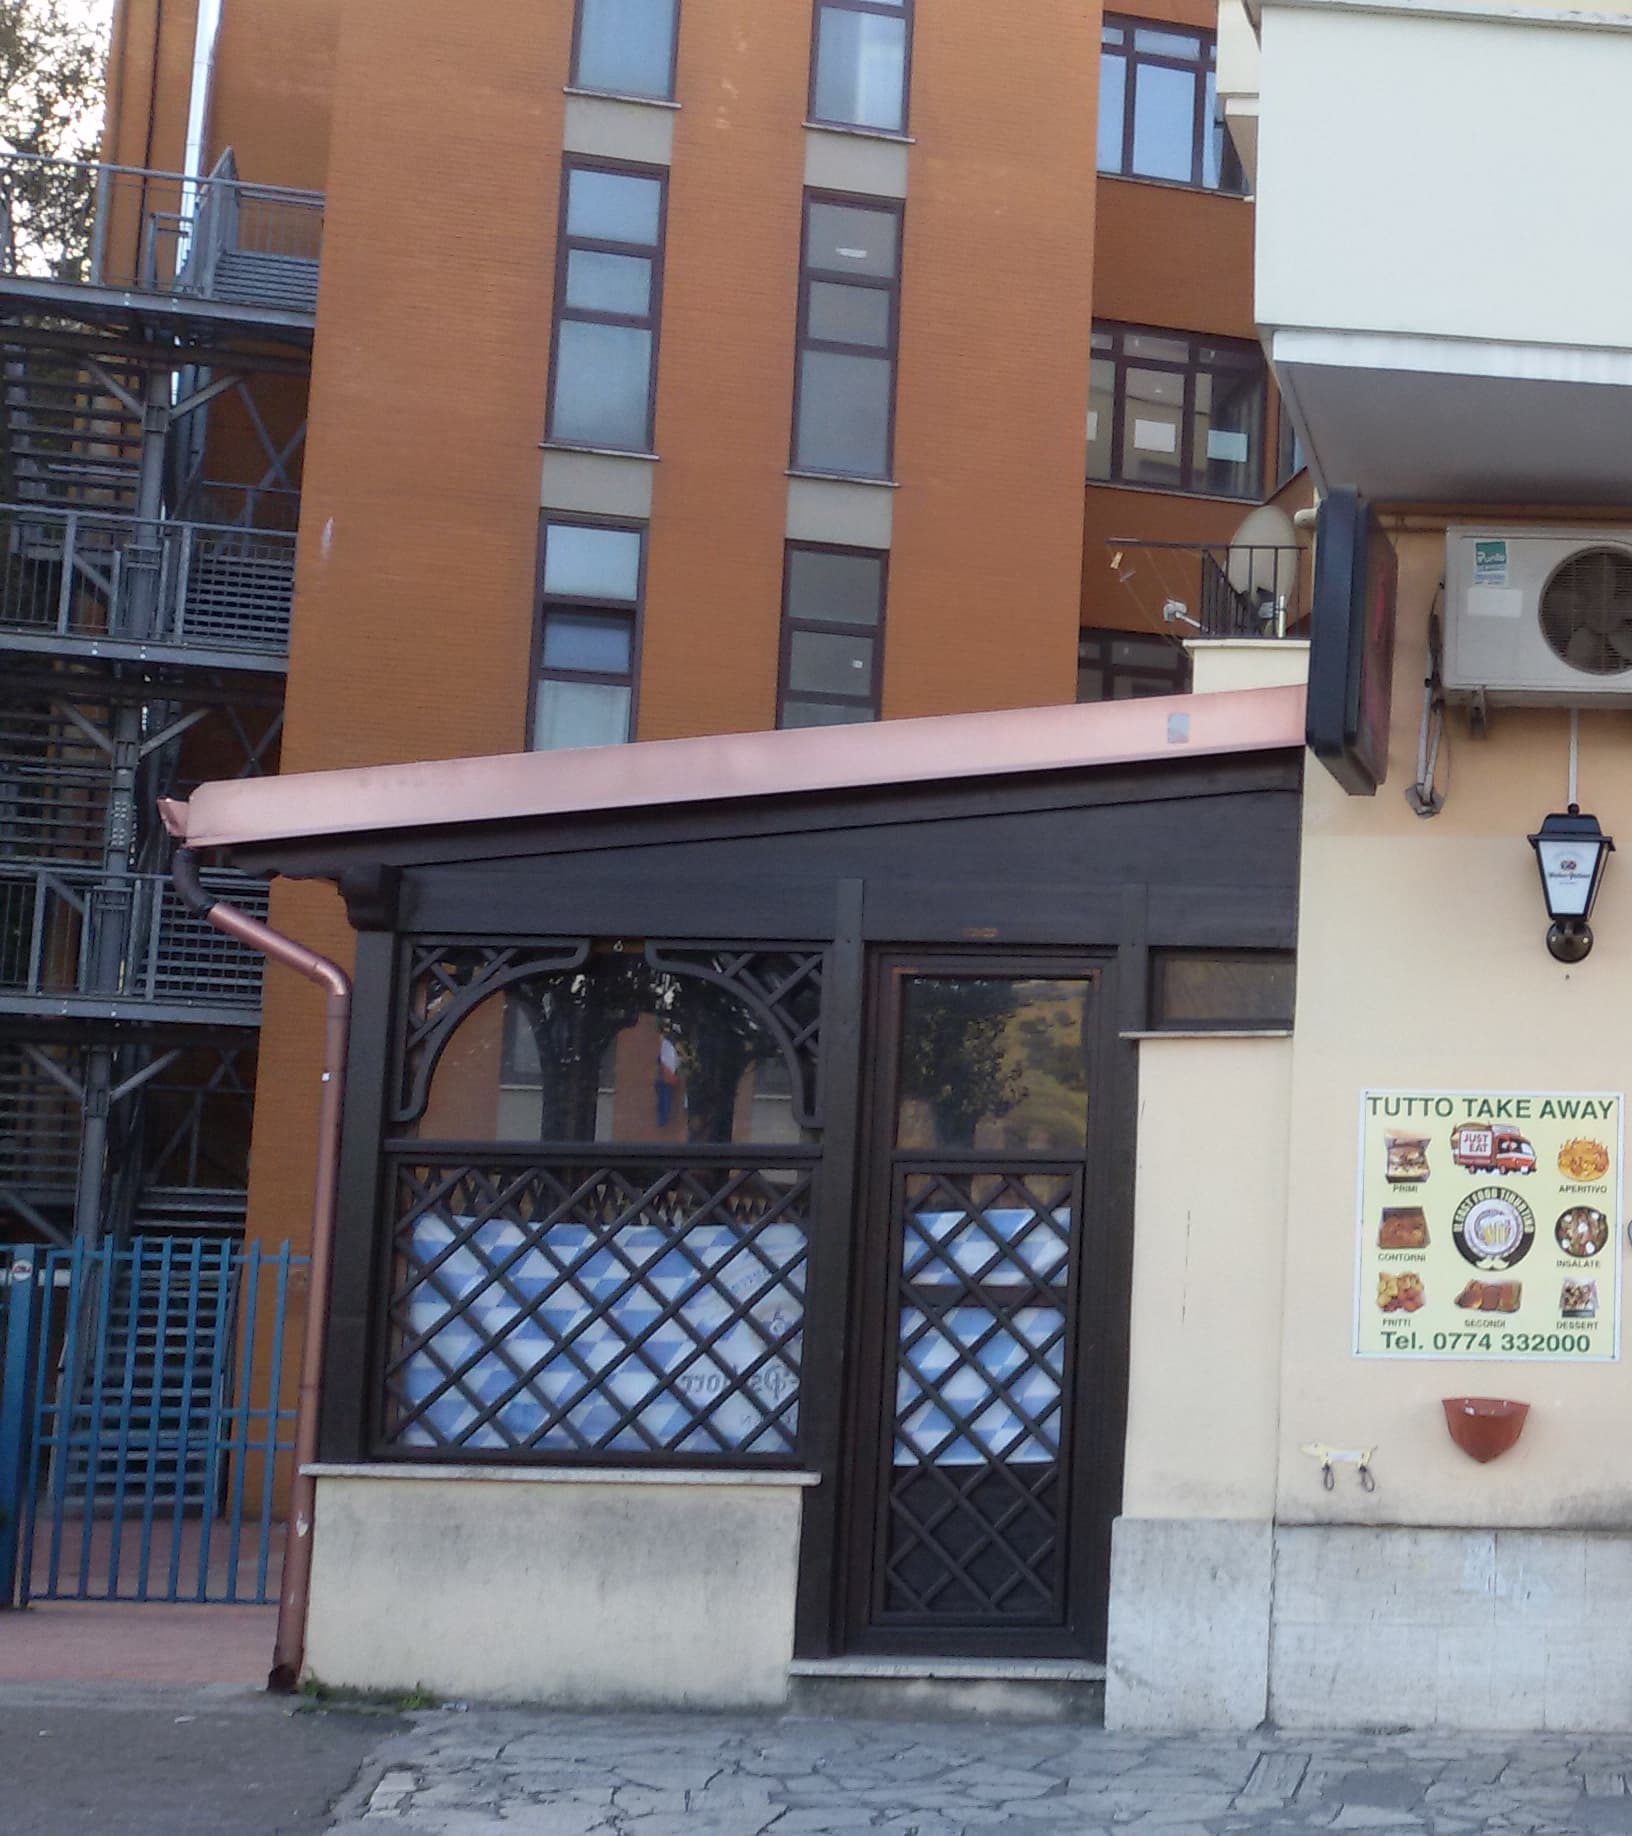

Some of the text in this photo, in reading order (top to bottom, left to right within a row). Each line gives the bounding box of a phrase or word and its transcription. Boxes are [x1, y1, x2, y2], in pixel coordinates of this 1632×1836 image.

[1367, 1096, 1614, 1120] TUTTO TAKE AWAY
[1463, 1133, 1489, 1144] JUST
[1469, 1143, 1489, 1154] EAT
[1392, 1184, 1418, 1194] PRIMI
[1558, 1184, 1608, 1195] APERITIVO
[1377, 1253, 1427, 1263] CONTORNI
[1555, 1259, 1601, 1269] INSALATE
[1382, 1318, 1412, 1328] FRITTI
[1464, 1319, 1506, 1329] SECONDI
[1556, 1320, 1599, 1331] DESSERT
[1380, 1331, 1591, 1353] Tel. 0774 332000
